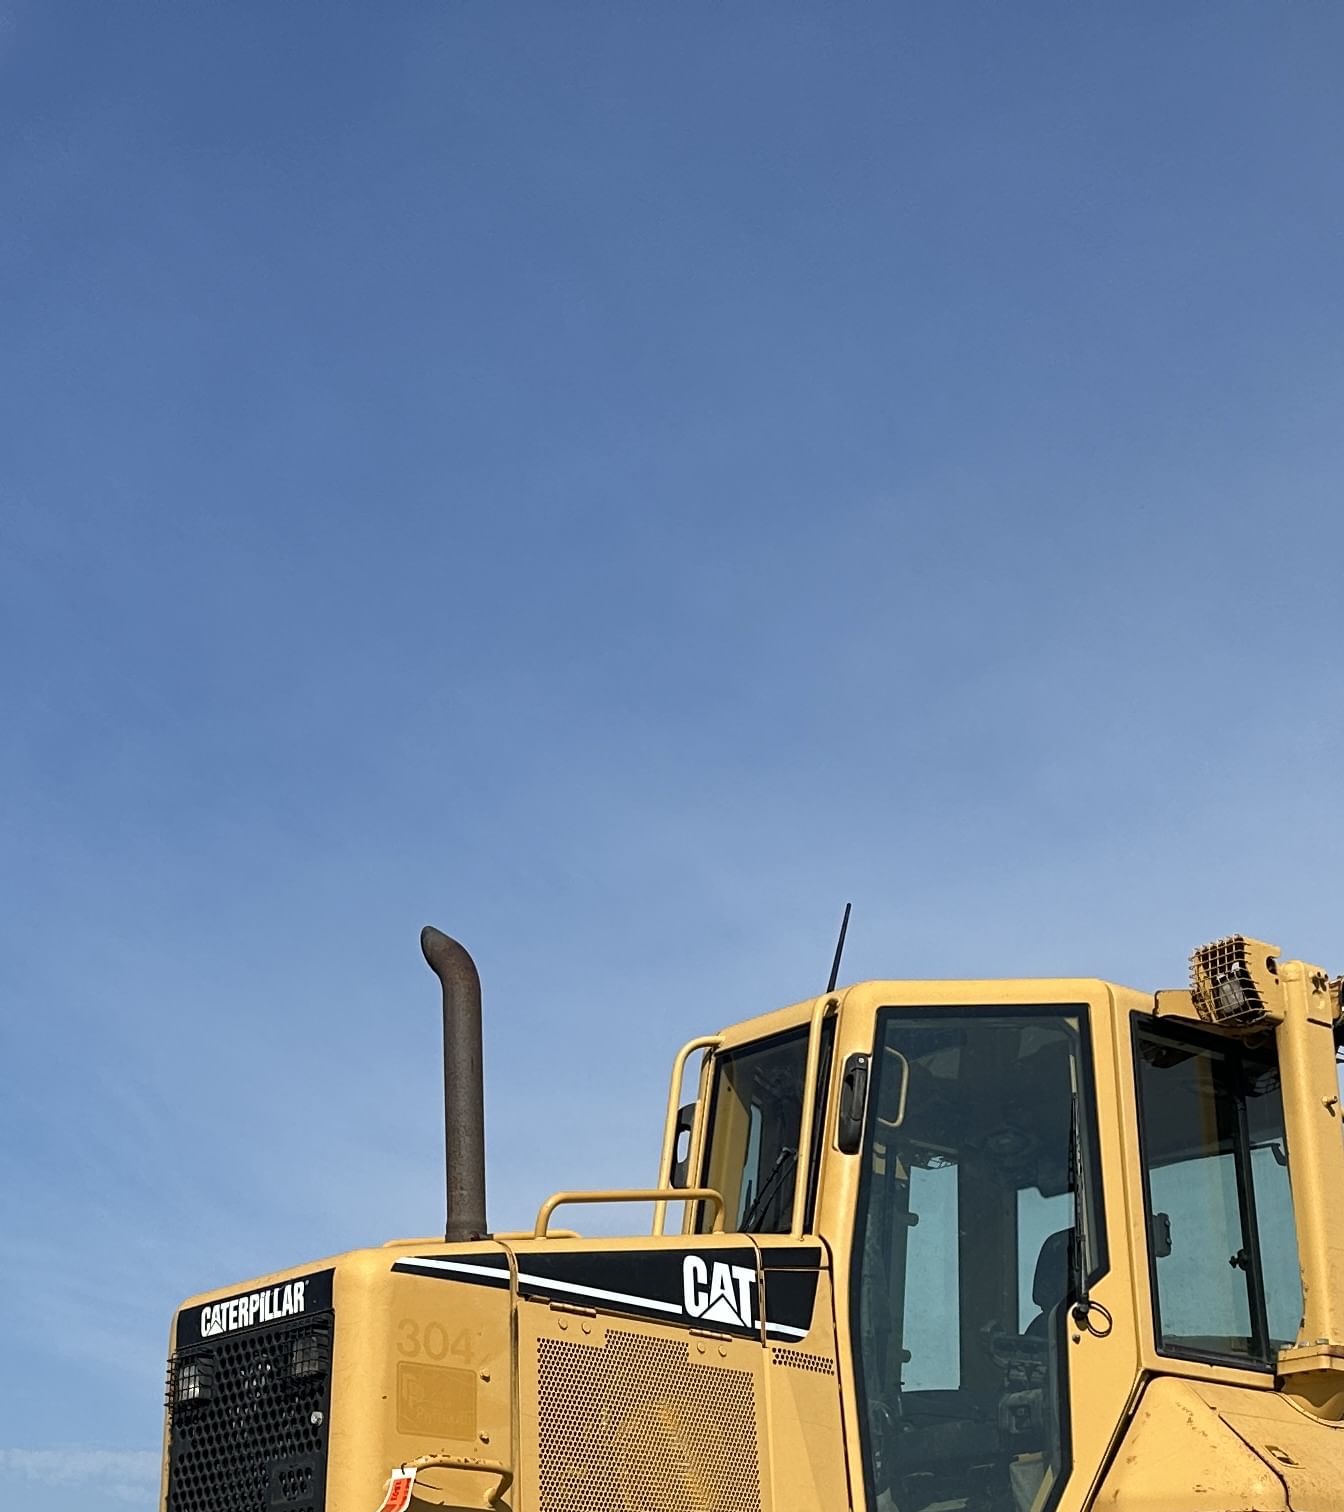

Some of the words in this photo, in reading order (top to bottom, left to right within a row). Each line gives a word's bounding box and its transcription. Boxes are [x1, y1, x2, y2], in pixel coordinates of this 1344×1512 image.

[200, 1281, 306, 1337] CATERPILLAR
[683, 1255, 757, 1328] CAT
[397, 1318, 475, 1364] 304
